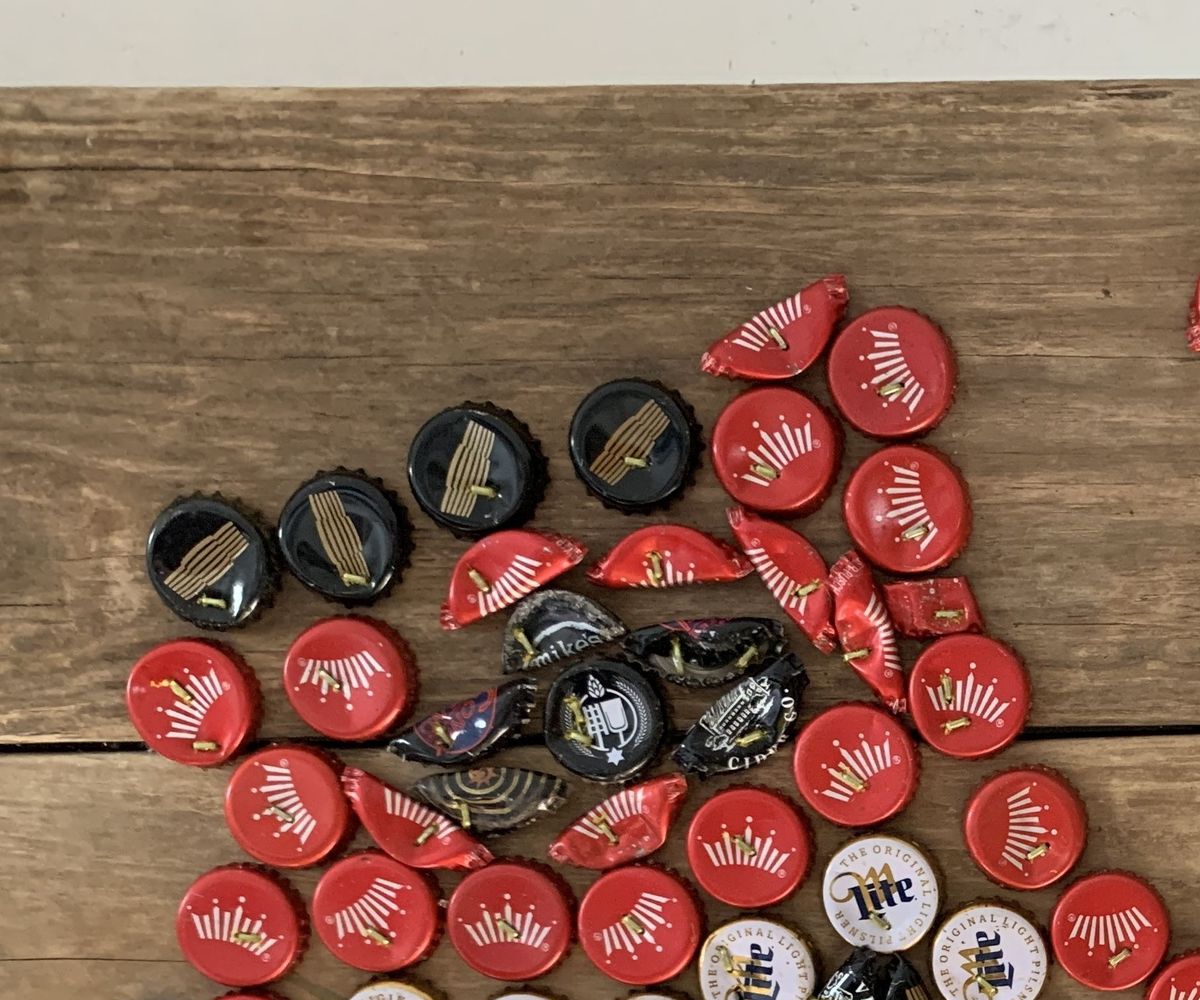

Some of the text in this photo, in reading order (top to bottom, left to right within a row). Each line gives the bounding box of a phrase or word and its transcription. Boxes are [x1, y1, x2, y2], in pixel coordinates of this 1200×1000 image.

[840, 848, 868, 867] THE
[873, 845, 932, 896] ORIGINAL
[940, 914, 997, 963] ORIGINAL
[1002, 916, 1039, 953] LIGHT
[708, 968, 720, 998] THE
[778, 937, 808, 980] LIGHT
[940, 969, 958, 997] THE
